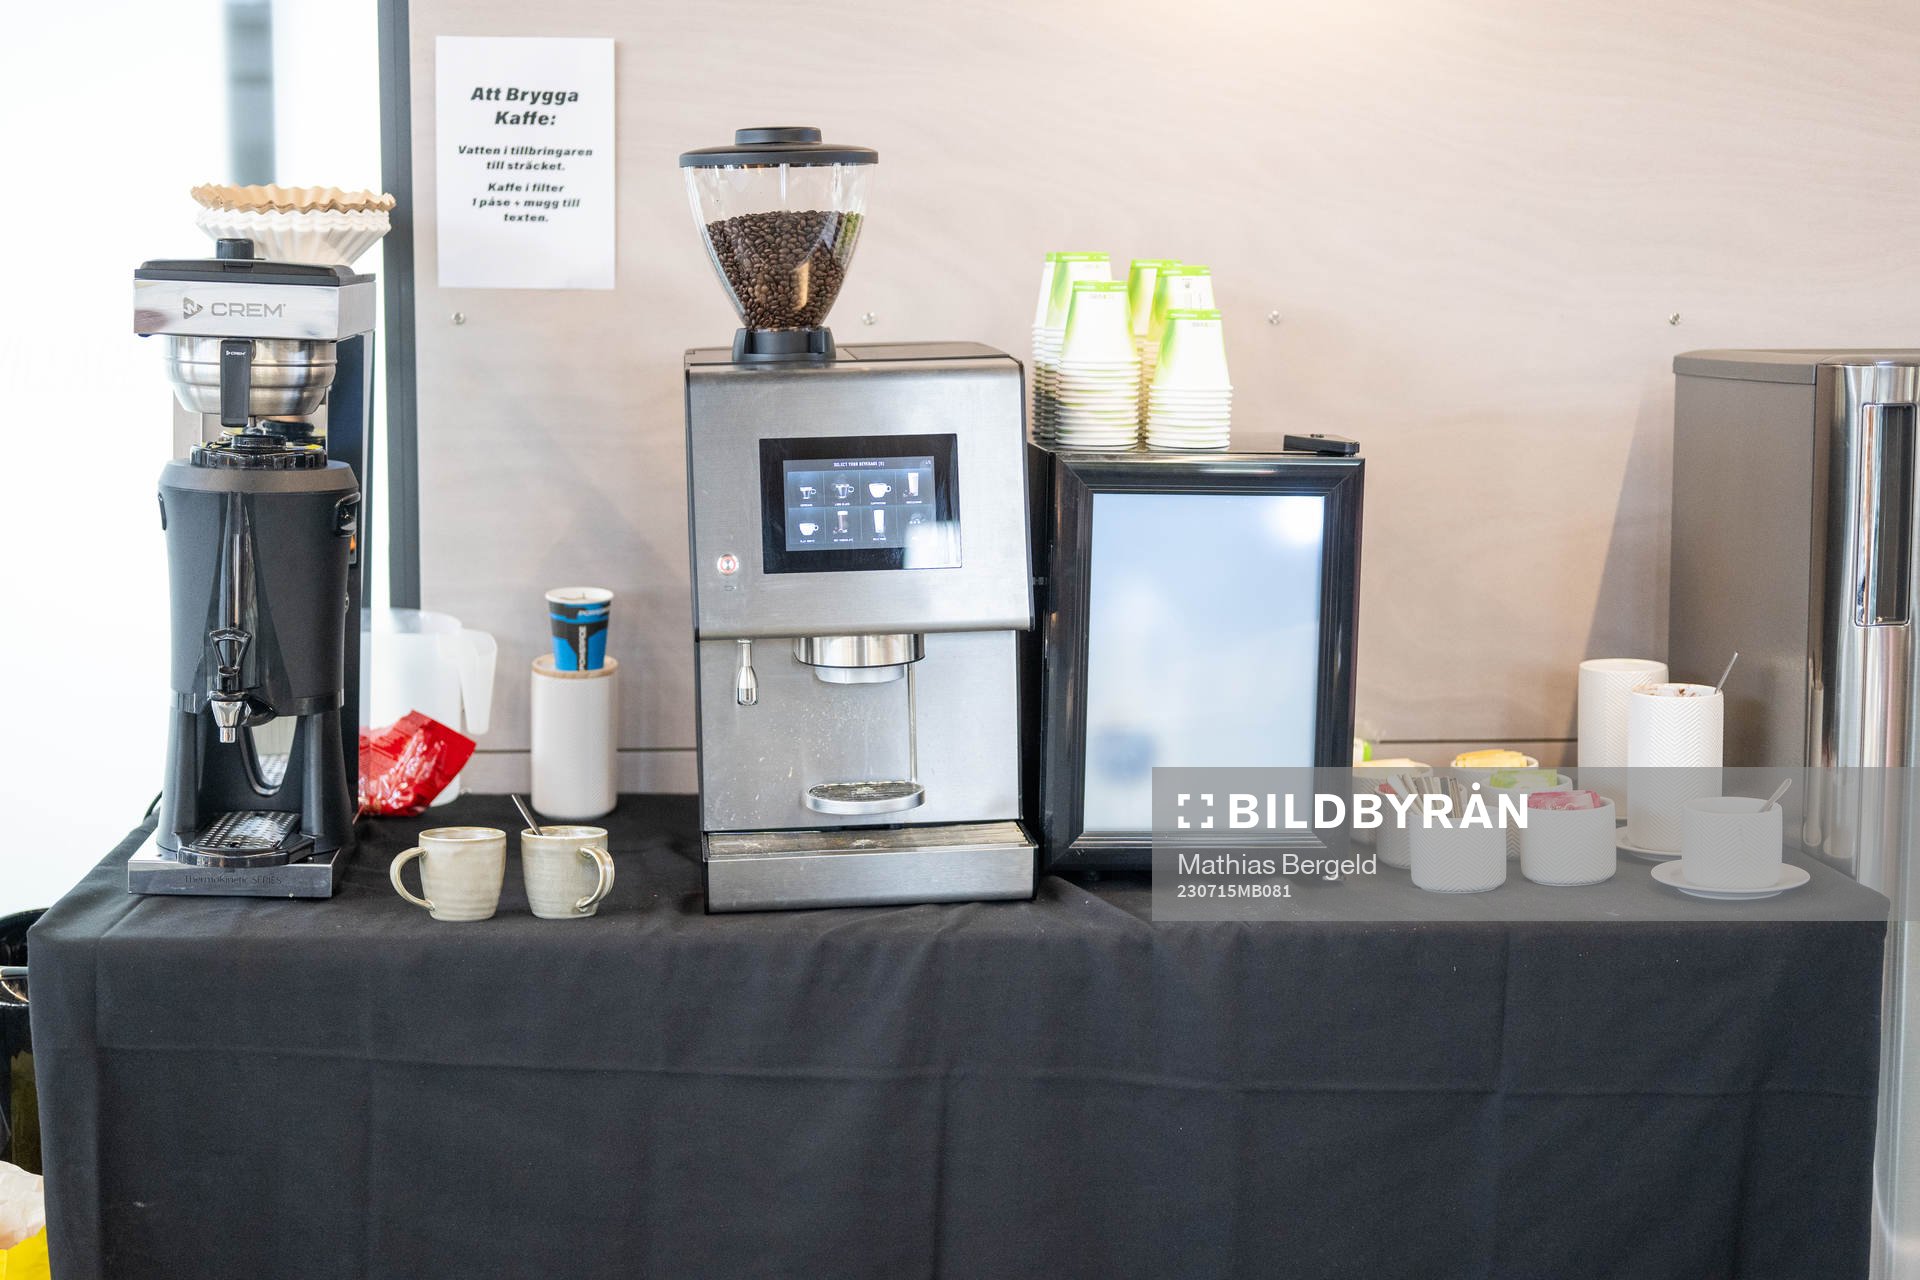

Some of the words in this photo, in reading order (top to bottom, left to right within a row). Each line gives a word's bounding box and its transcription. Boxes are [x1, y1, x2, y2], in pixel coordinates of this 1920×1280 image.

[470, 87, 502, 102] Att
[505, 87, 579, 106] Brygga
[494, 110, 557, 126] Kaffe:
[458, 145, 501, 156] Vatten
[503, 146, 508, 156] i
[510, 145, 594, 158] tillbringaren
[486, 161, 505, 170] till
[487, 182, 523, 193] Kaffe
[525, 183, 530, 193] i
[532, 182, 565, 193] filter
[478, 197, 511, 209] påse
[523, 198, 560, 210] mugg
[562, 198, 581, 209] till
[503, 213, 549, 223] texten.
[211, 302, 286, 318] CREM
